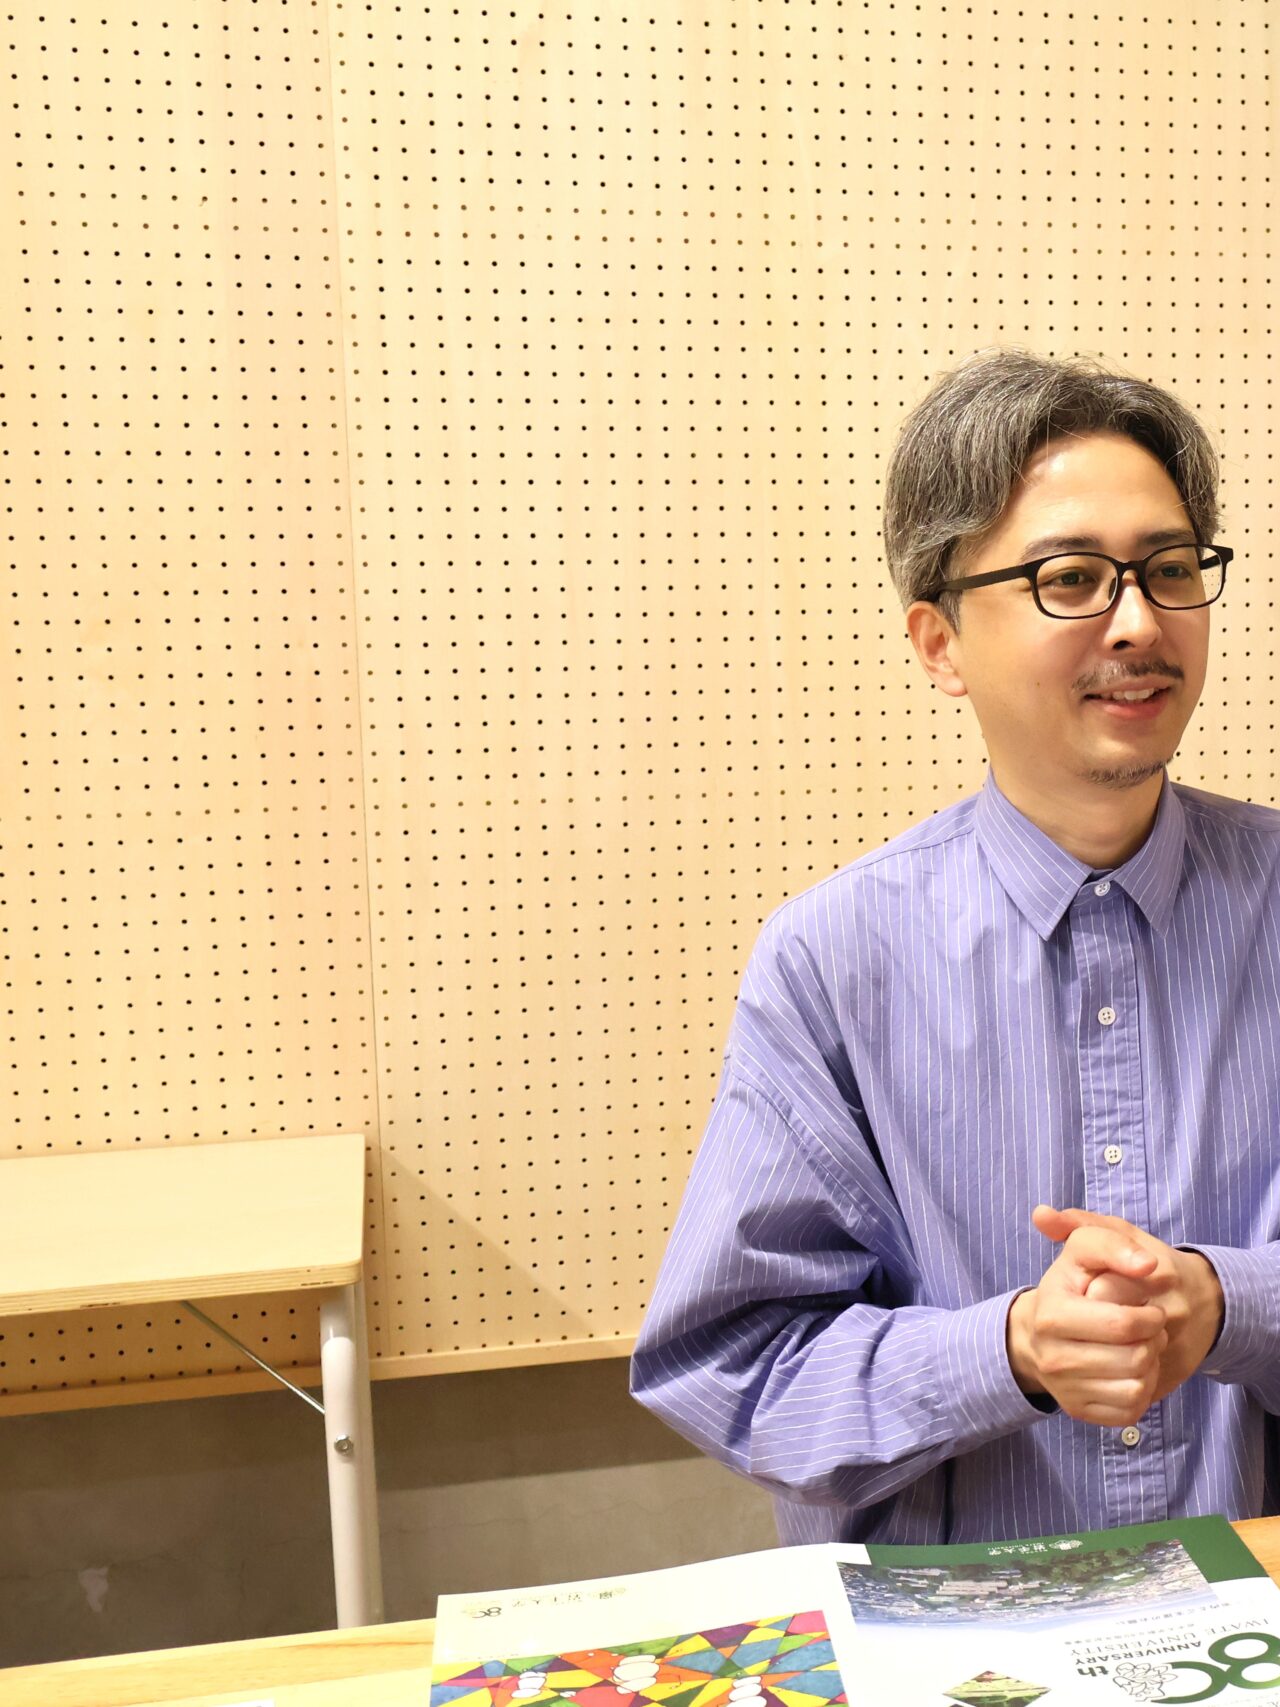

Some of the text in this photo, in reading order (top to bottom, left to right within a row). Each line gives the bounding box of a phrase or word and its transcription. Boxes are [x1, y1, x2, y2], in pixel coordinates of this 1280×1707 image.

[1203, 1617, 1269, 1636] IWATE
[1068, 1631, 1196, 1657] UNIVERSITY
[1073, 1640, 1202, 1666] ANNIVERSARY
